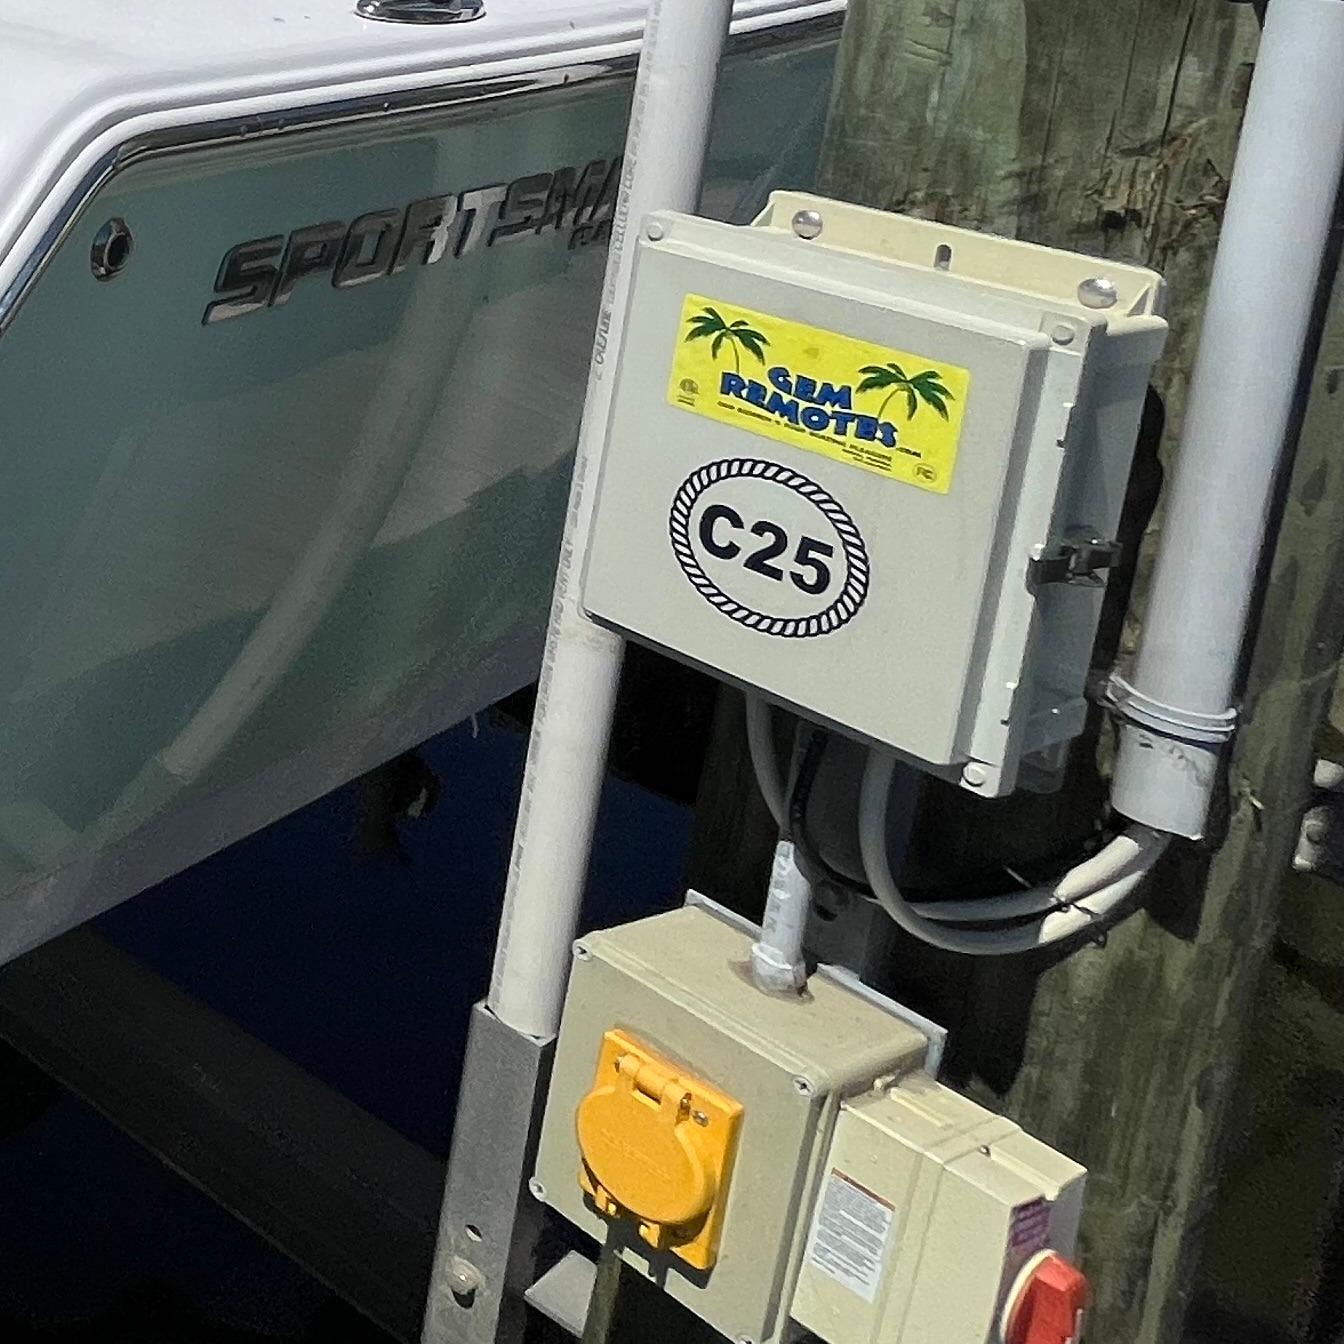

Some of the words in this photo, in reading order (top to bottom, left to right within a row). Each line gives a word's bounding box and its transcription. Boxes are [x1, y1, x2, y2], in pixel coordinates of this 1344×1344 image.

[718, 371, 898, 448] REMOTES
[767, 367, 852, 409] GEM
[699, 504, 834, 595] C25
